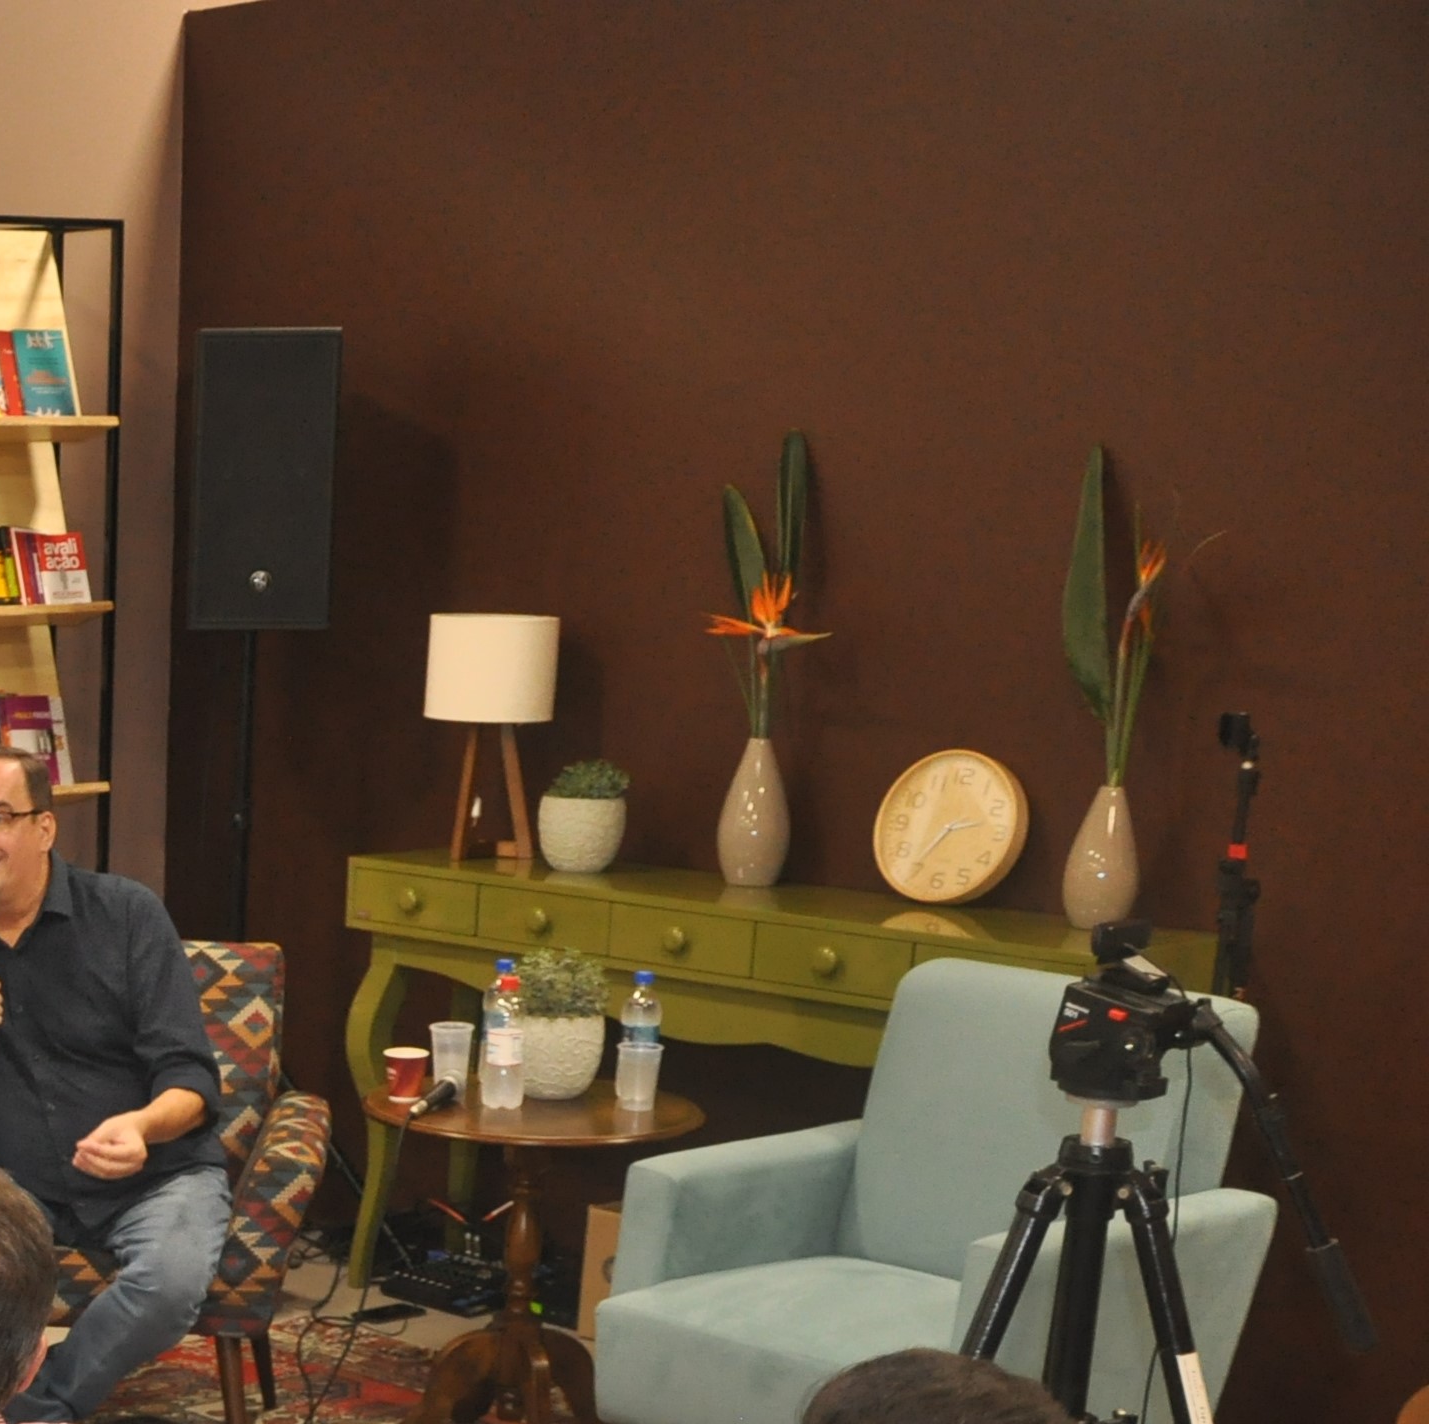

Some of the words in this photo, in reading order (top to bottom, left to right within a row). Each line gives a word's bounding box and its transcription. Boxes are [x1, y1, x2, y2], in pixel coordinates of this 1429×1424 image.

[931, 773, 948, 792] 11
[953, 767, 976, 786] 12
[907, 791, 927, 809] 10
[989, 799, 1005, 817] 2
[894, 814, 909, 832] 9
[992, 825, 1007, 842] 3
[896, 841, 911, 859] 8
[976, 850, 992, 867] 4
[929, 872, 944, 890] 6
[956, 867, 972, 886] 5
